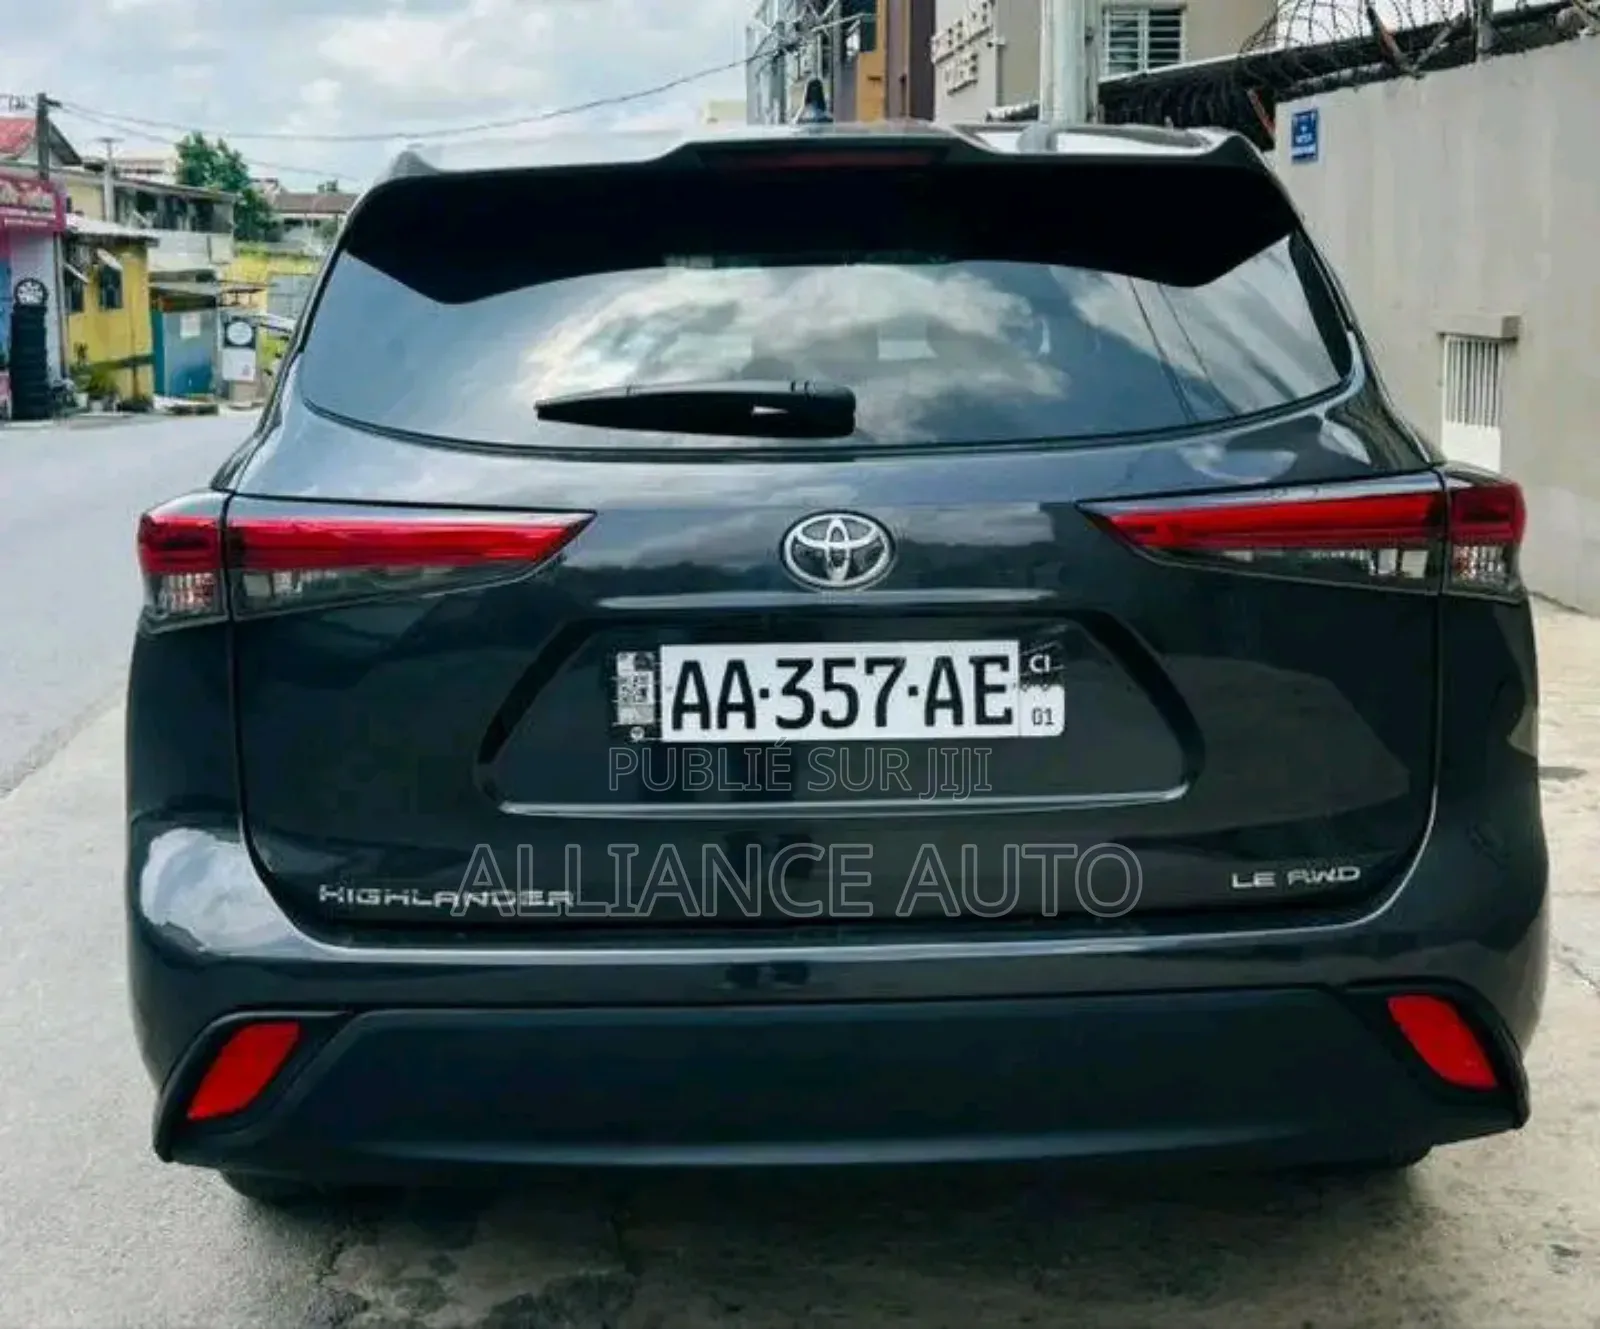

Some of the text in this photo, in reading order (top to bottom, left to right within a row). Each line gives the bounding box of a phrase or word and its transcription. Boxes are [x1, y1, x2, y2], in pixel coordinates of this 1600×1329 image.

[1029, 654, 1051, 673] CI
[1031, 706, 1055, 726] 01
[1231, 871, 1277, 889] LE
[318, 883, 575, 908] HIGHLANDER
